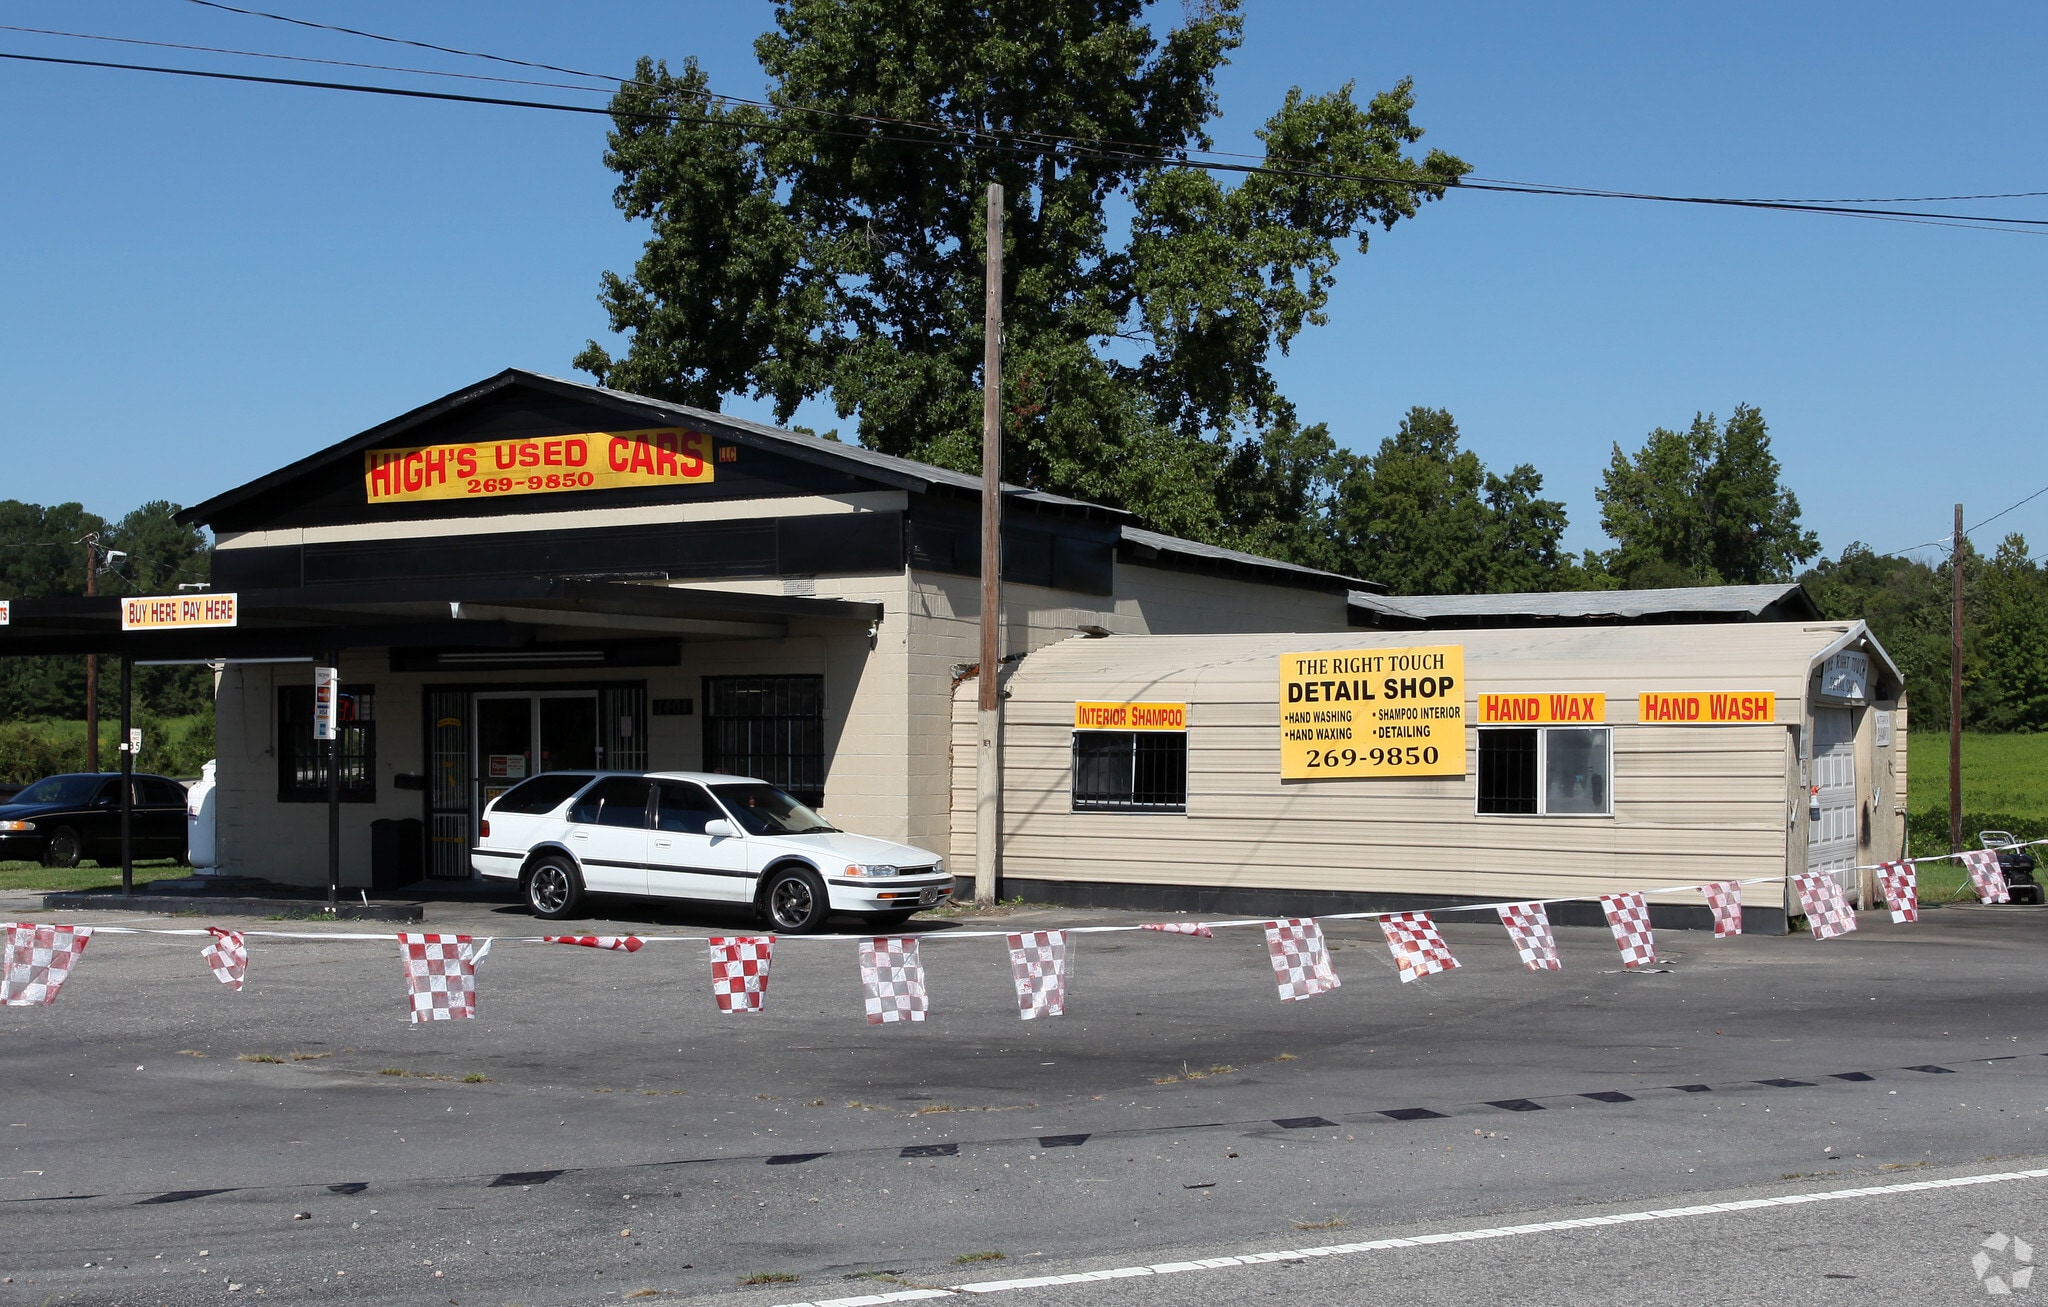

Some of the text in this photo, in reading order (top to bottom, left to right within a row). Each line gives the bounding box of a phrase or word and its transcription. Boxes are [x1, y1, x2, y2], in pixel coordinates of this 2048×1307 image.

[372, 432, 703, 496] HIGH'S USED CARS
[719, 447, 736, 462] LLC
[467, 471, 594, 494] 269-9850
[129, 602, 147, 623] BUY
[151, 602, 176, 622] HERE
[205, 599, 233, 620] HERE
[1296, 654, 1444, 675] THE RIGHT TOUCH
[1288, 676, 1454, 703] DETAIL SHOP
[1079, 705, 1182, 727] INTERIOR SHAMPOO
[1289, 710, 1352, 724] HAND WASHING
[1378, 706, 1460, 721] SHAMPOO INTERIOR
[1486, 694, 1595, 721] HAND WAX
[1645, 694, 1768, 721] HAND WASH
[1289, 727, 1352, 741] HAND WAXING
[1379, 725, 1430, 739] DETAILING
[1306, 746, 1439, 768] 269-9850
